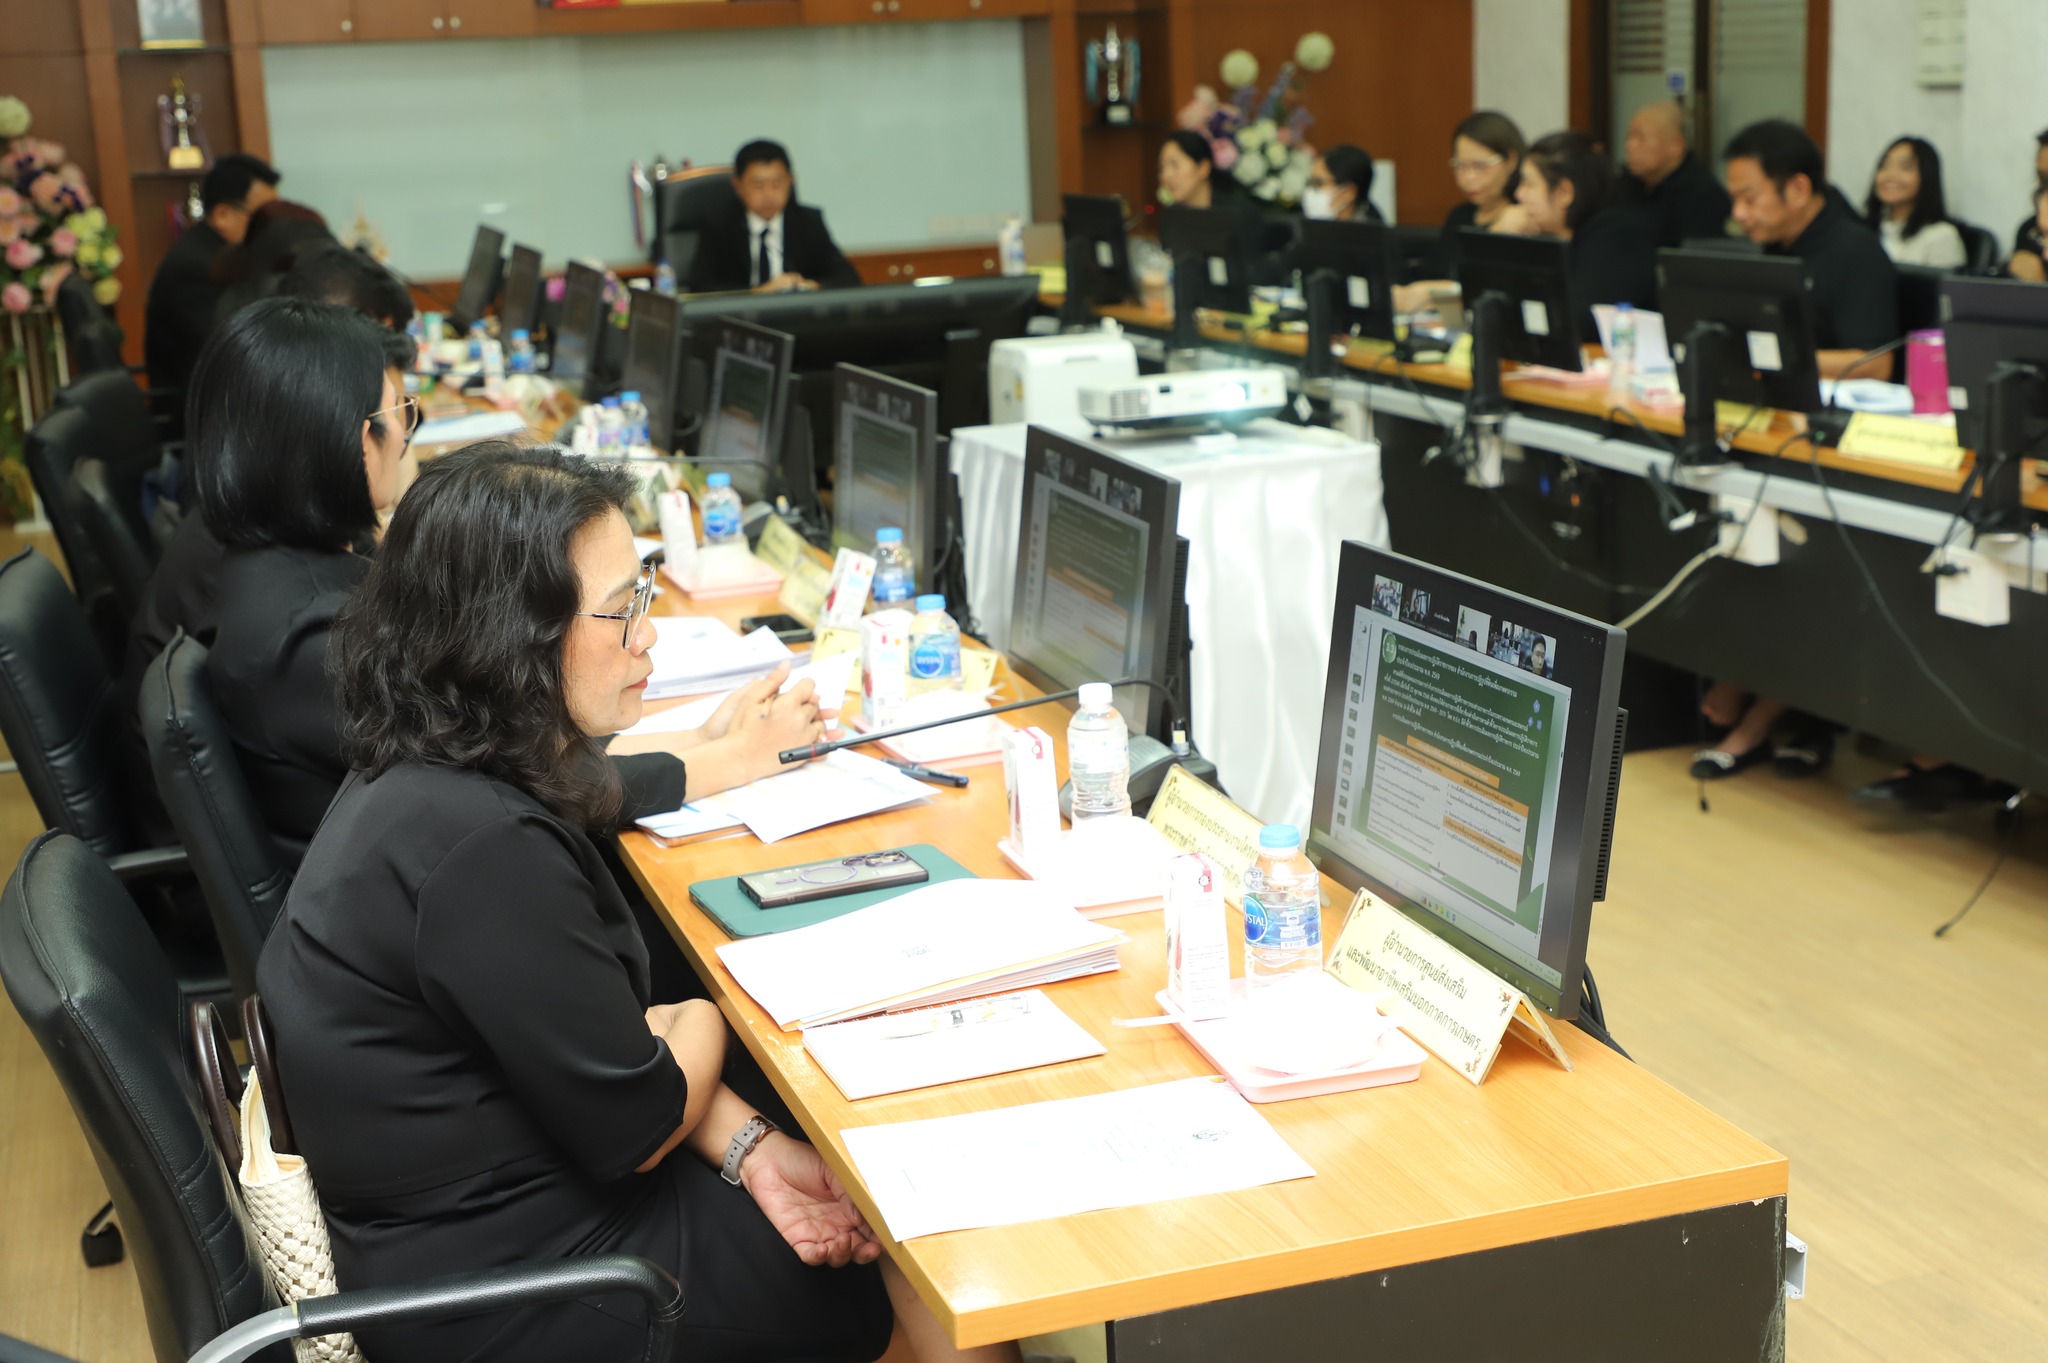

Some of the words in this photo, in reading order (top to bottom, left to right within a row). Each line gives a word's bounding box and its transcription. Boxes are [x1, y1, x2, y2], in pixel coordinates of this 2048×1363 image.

[1165, 786, 1259, 861] ผู้อำนวยการกองประสานงานโครงก
[1346, 945, 1481, 1052] และพัฒนาอาชีพเสริมนอกภาคการเกษตร
[1382, 929, 1468, 1000] ผู้อำนวยการศูนย์ส่งเสริม
